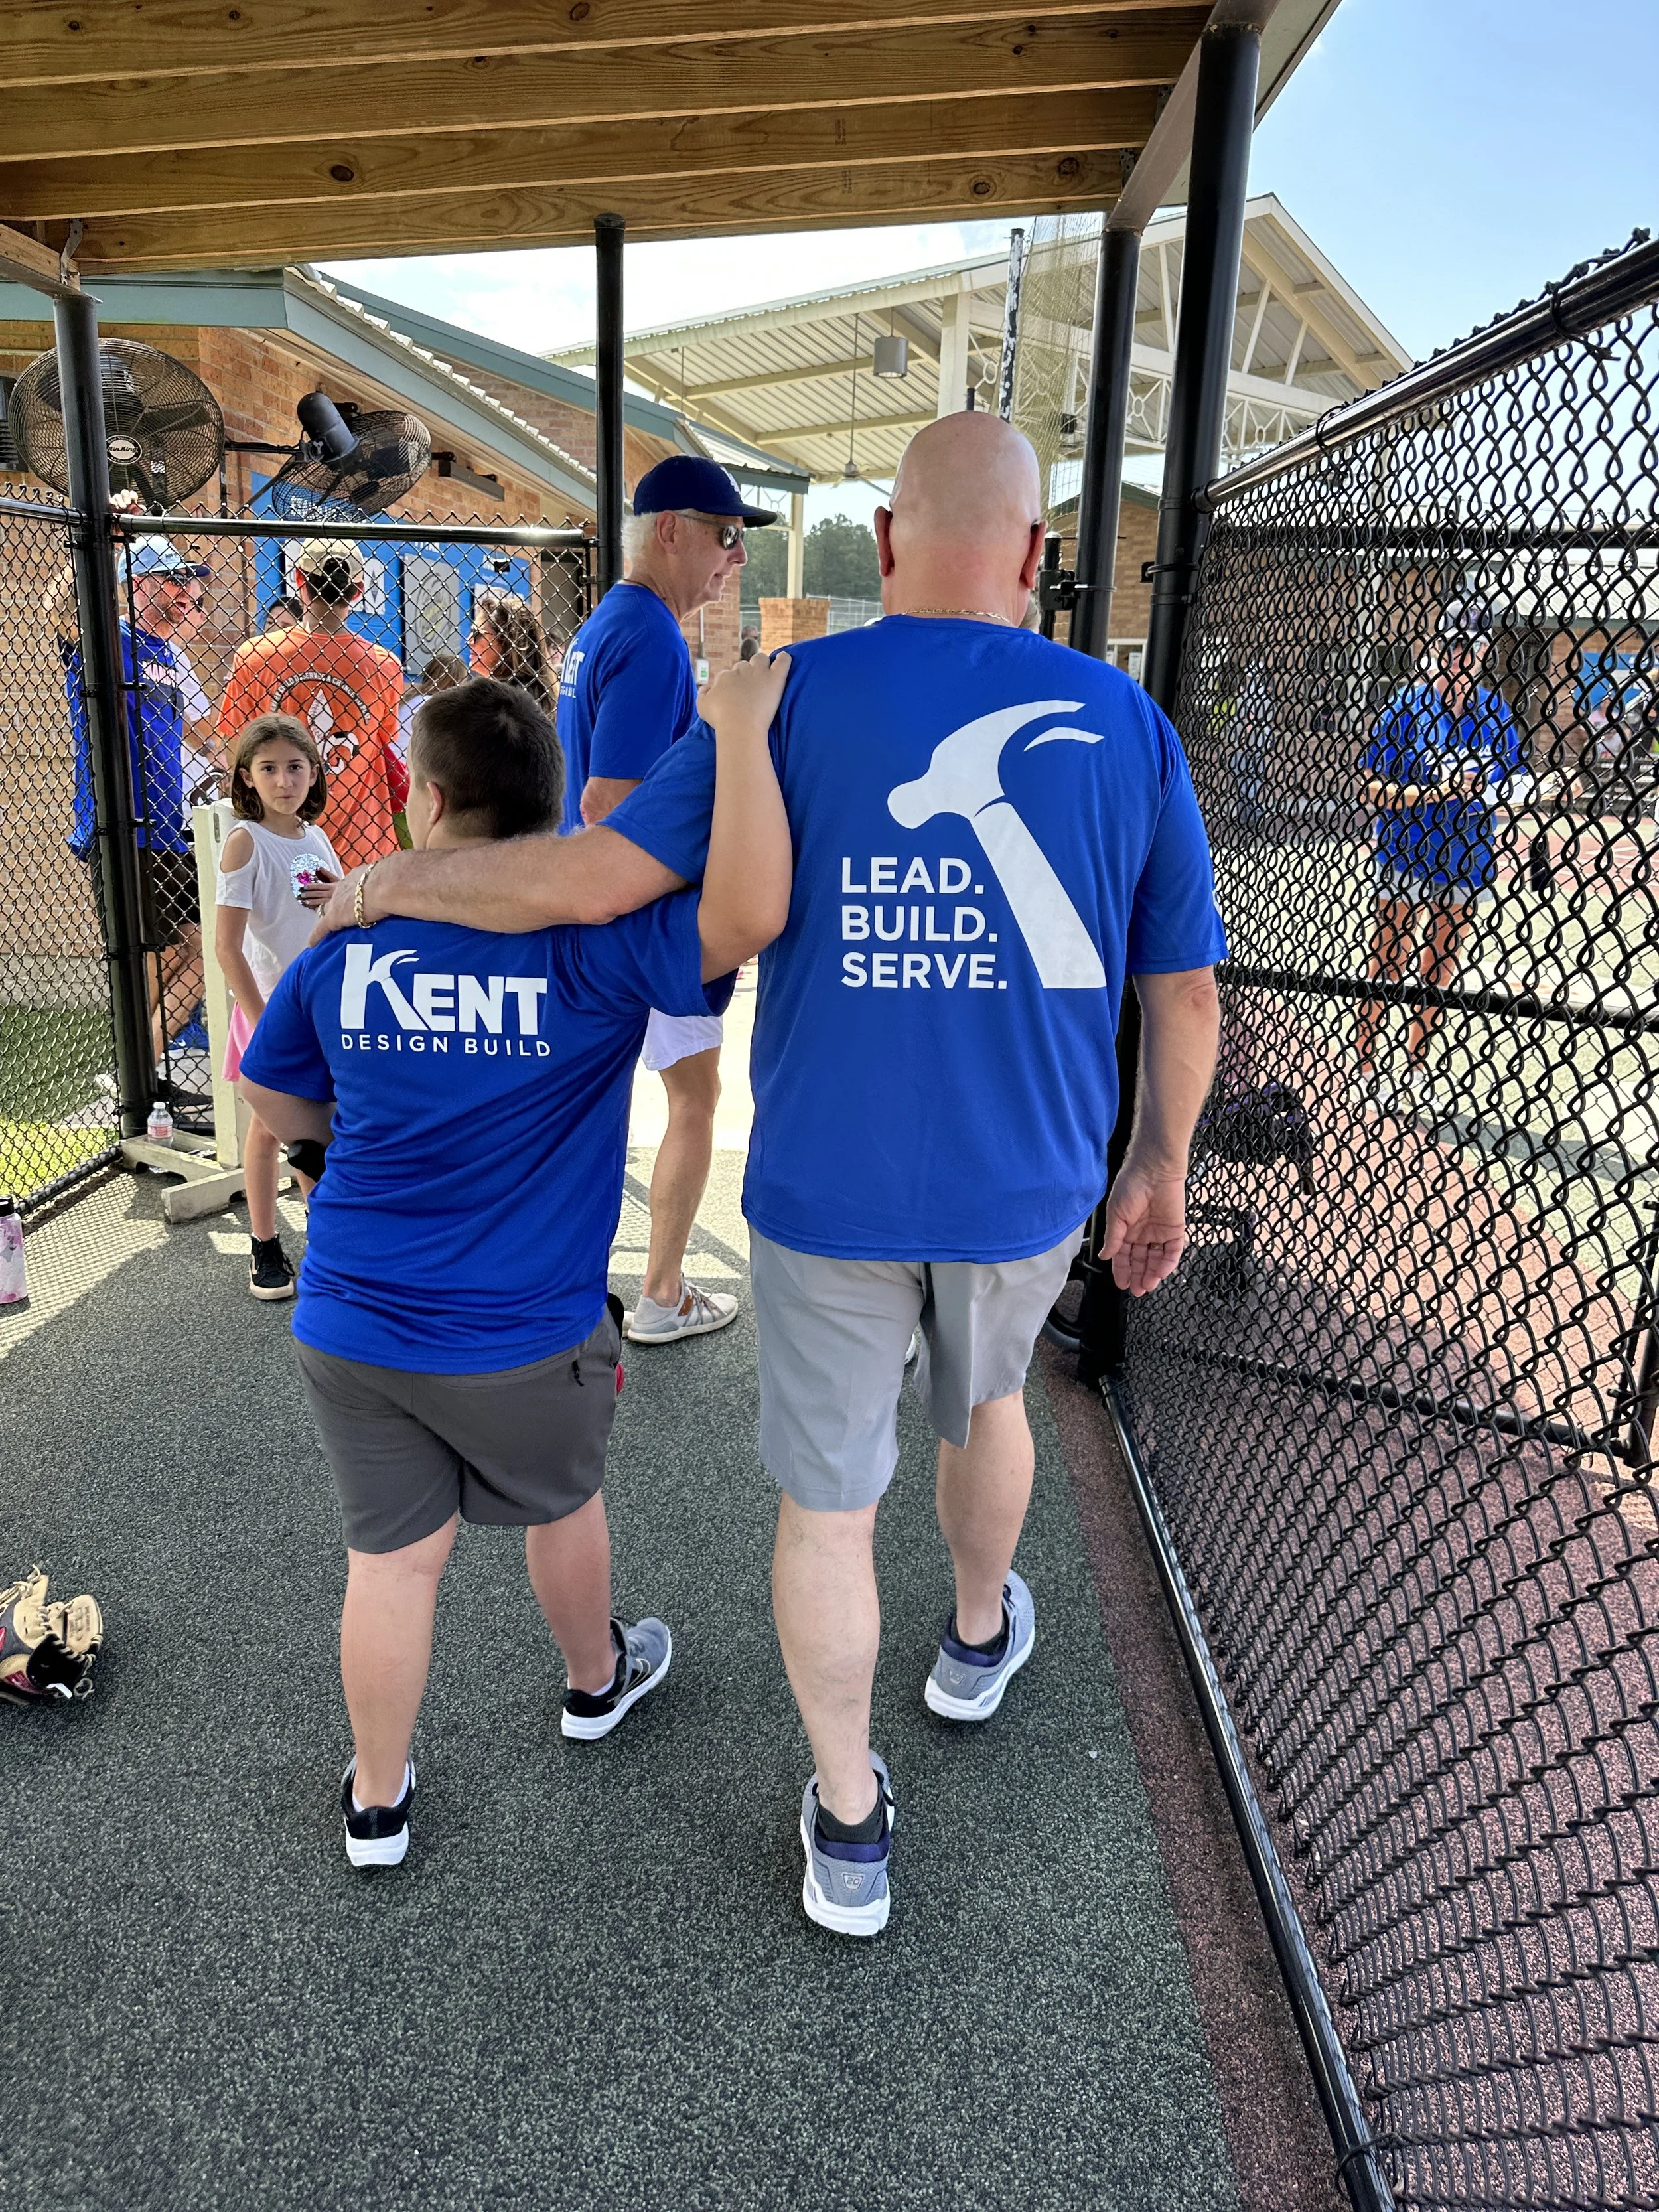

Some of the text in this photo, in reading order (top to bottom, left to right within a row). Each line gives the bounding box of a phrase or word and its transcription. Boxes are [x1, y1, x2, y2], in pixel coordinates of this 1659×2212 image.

[293, 672, 325, 682] DSERVES
[841, 857, 984, 894] LEAD.
[841, 905, 998, 942] BUILD.
[340, 943, 548, 1035] KENT
[841, 952, 1007, 990] SERVE.
[341, 1033, 551, 1057] DESIGN BUILD
